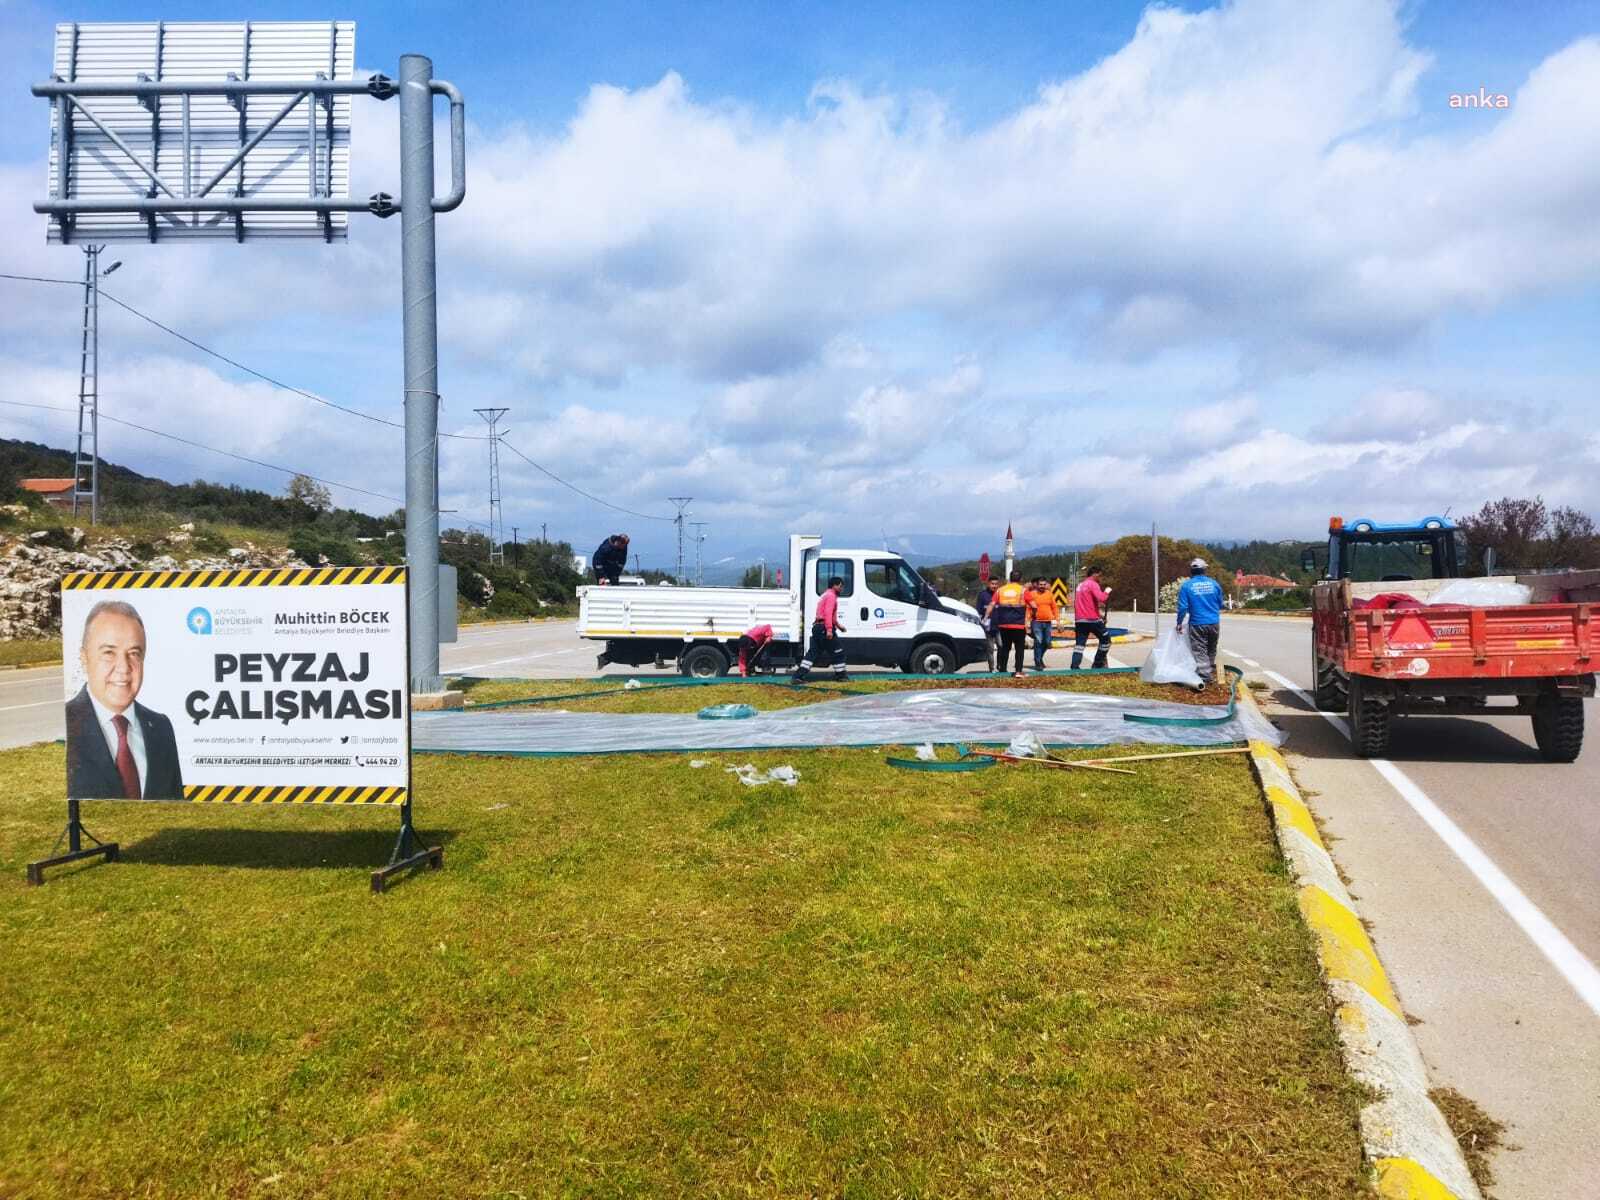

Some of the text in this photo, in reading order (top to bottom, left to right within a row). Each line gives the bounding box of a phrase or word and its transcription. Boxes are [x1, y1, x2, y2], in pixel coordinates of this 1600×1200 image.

[274, 608, 390, 624] Muhittin BÖCEK
[214, 652, 369, 683] PEYZAJ
[185, 689, 402, 726] ÇALIŞMASI
[195, 757, 222, 765] ANTALYA
